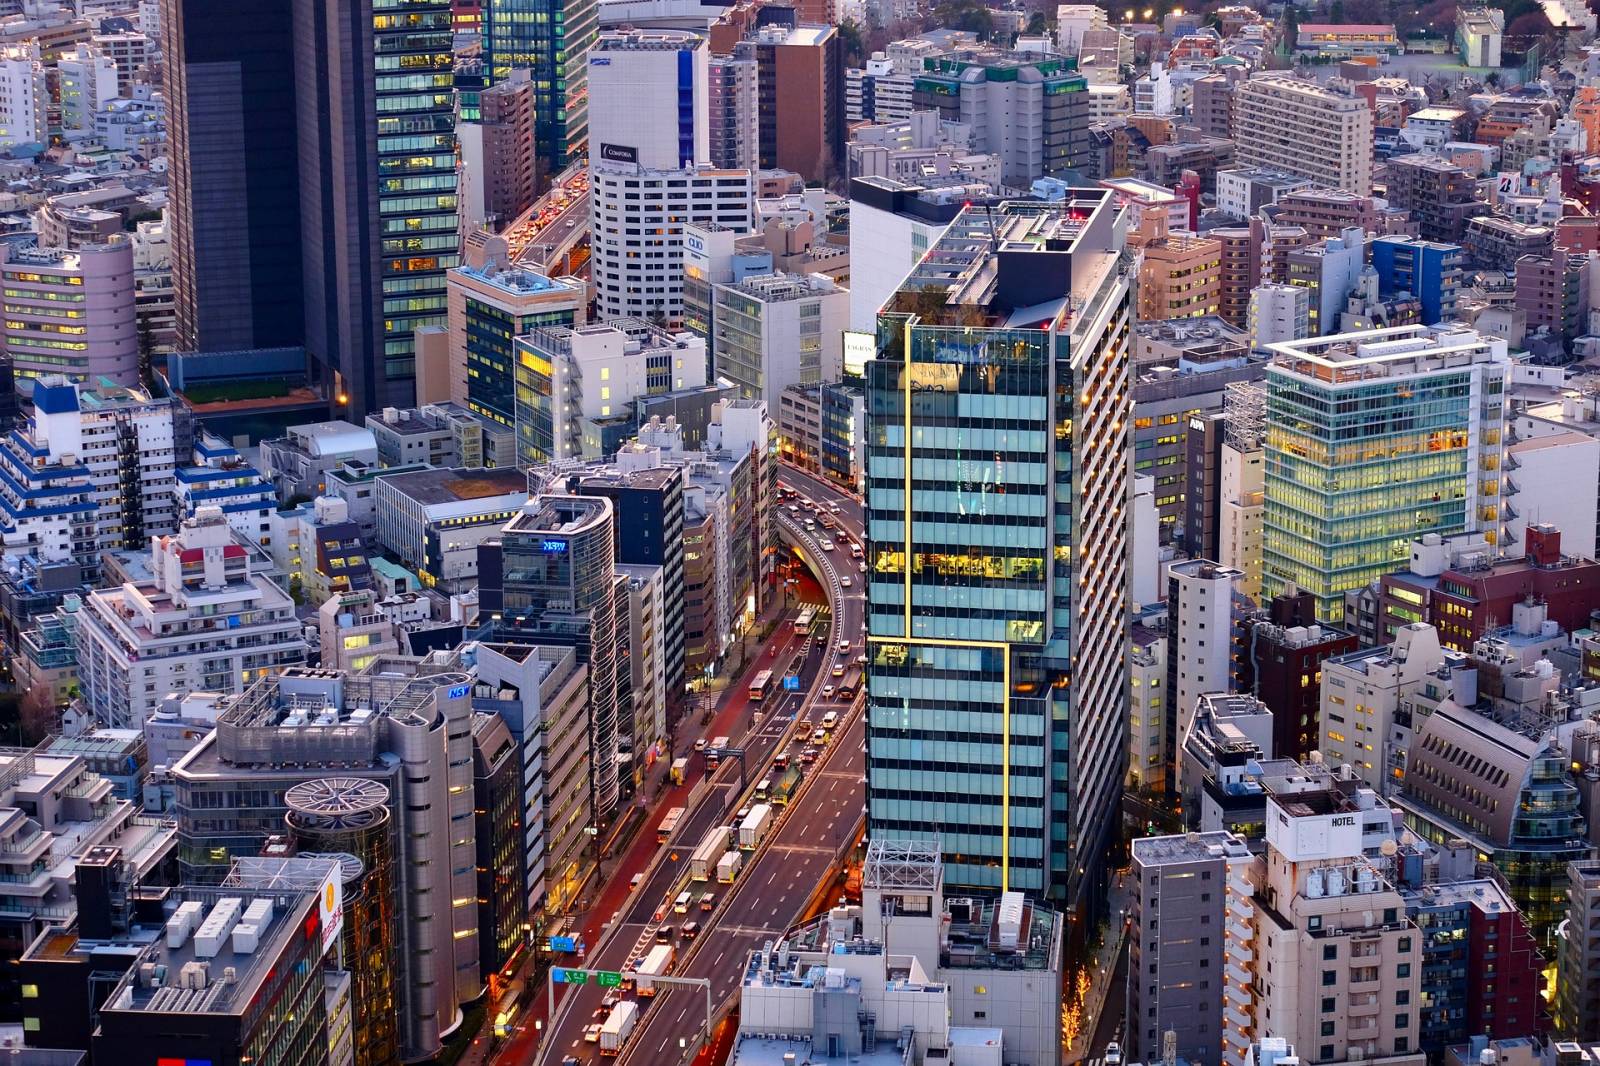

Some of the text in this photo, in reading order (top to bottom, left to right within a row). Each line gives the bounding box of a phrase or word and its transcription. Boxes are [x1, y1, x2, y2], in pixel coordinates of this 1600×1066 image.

[1190, 418, 1205, 432] APA
[449, 685, 470, 699] NSW
[1332, 817, 1355, 827] HOTEL
